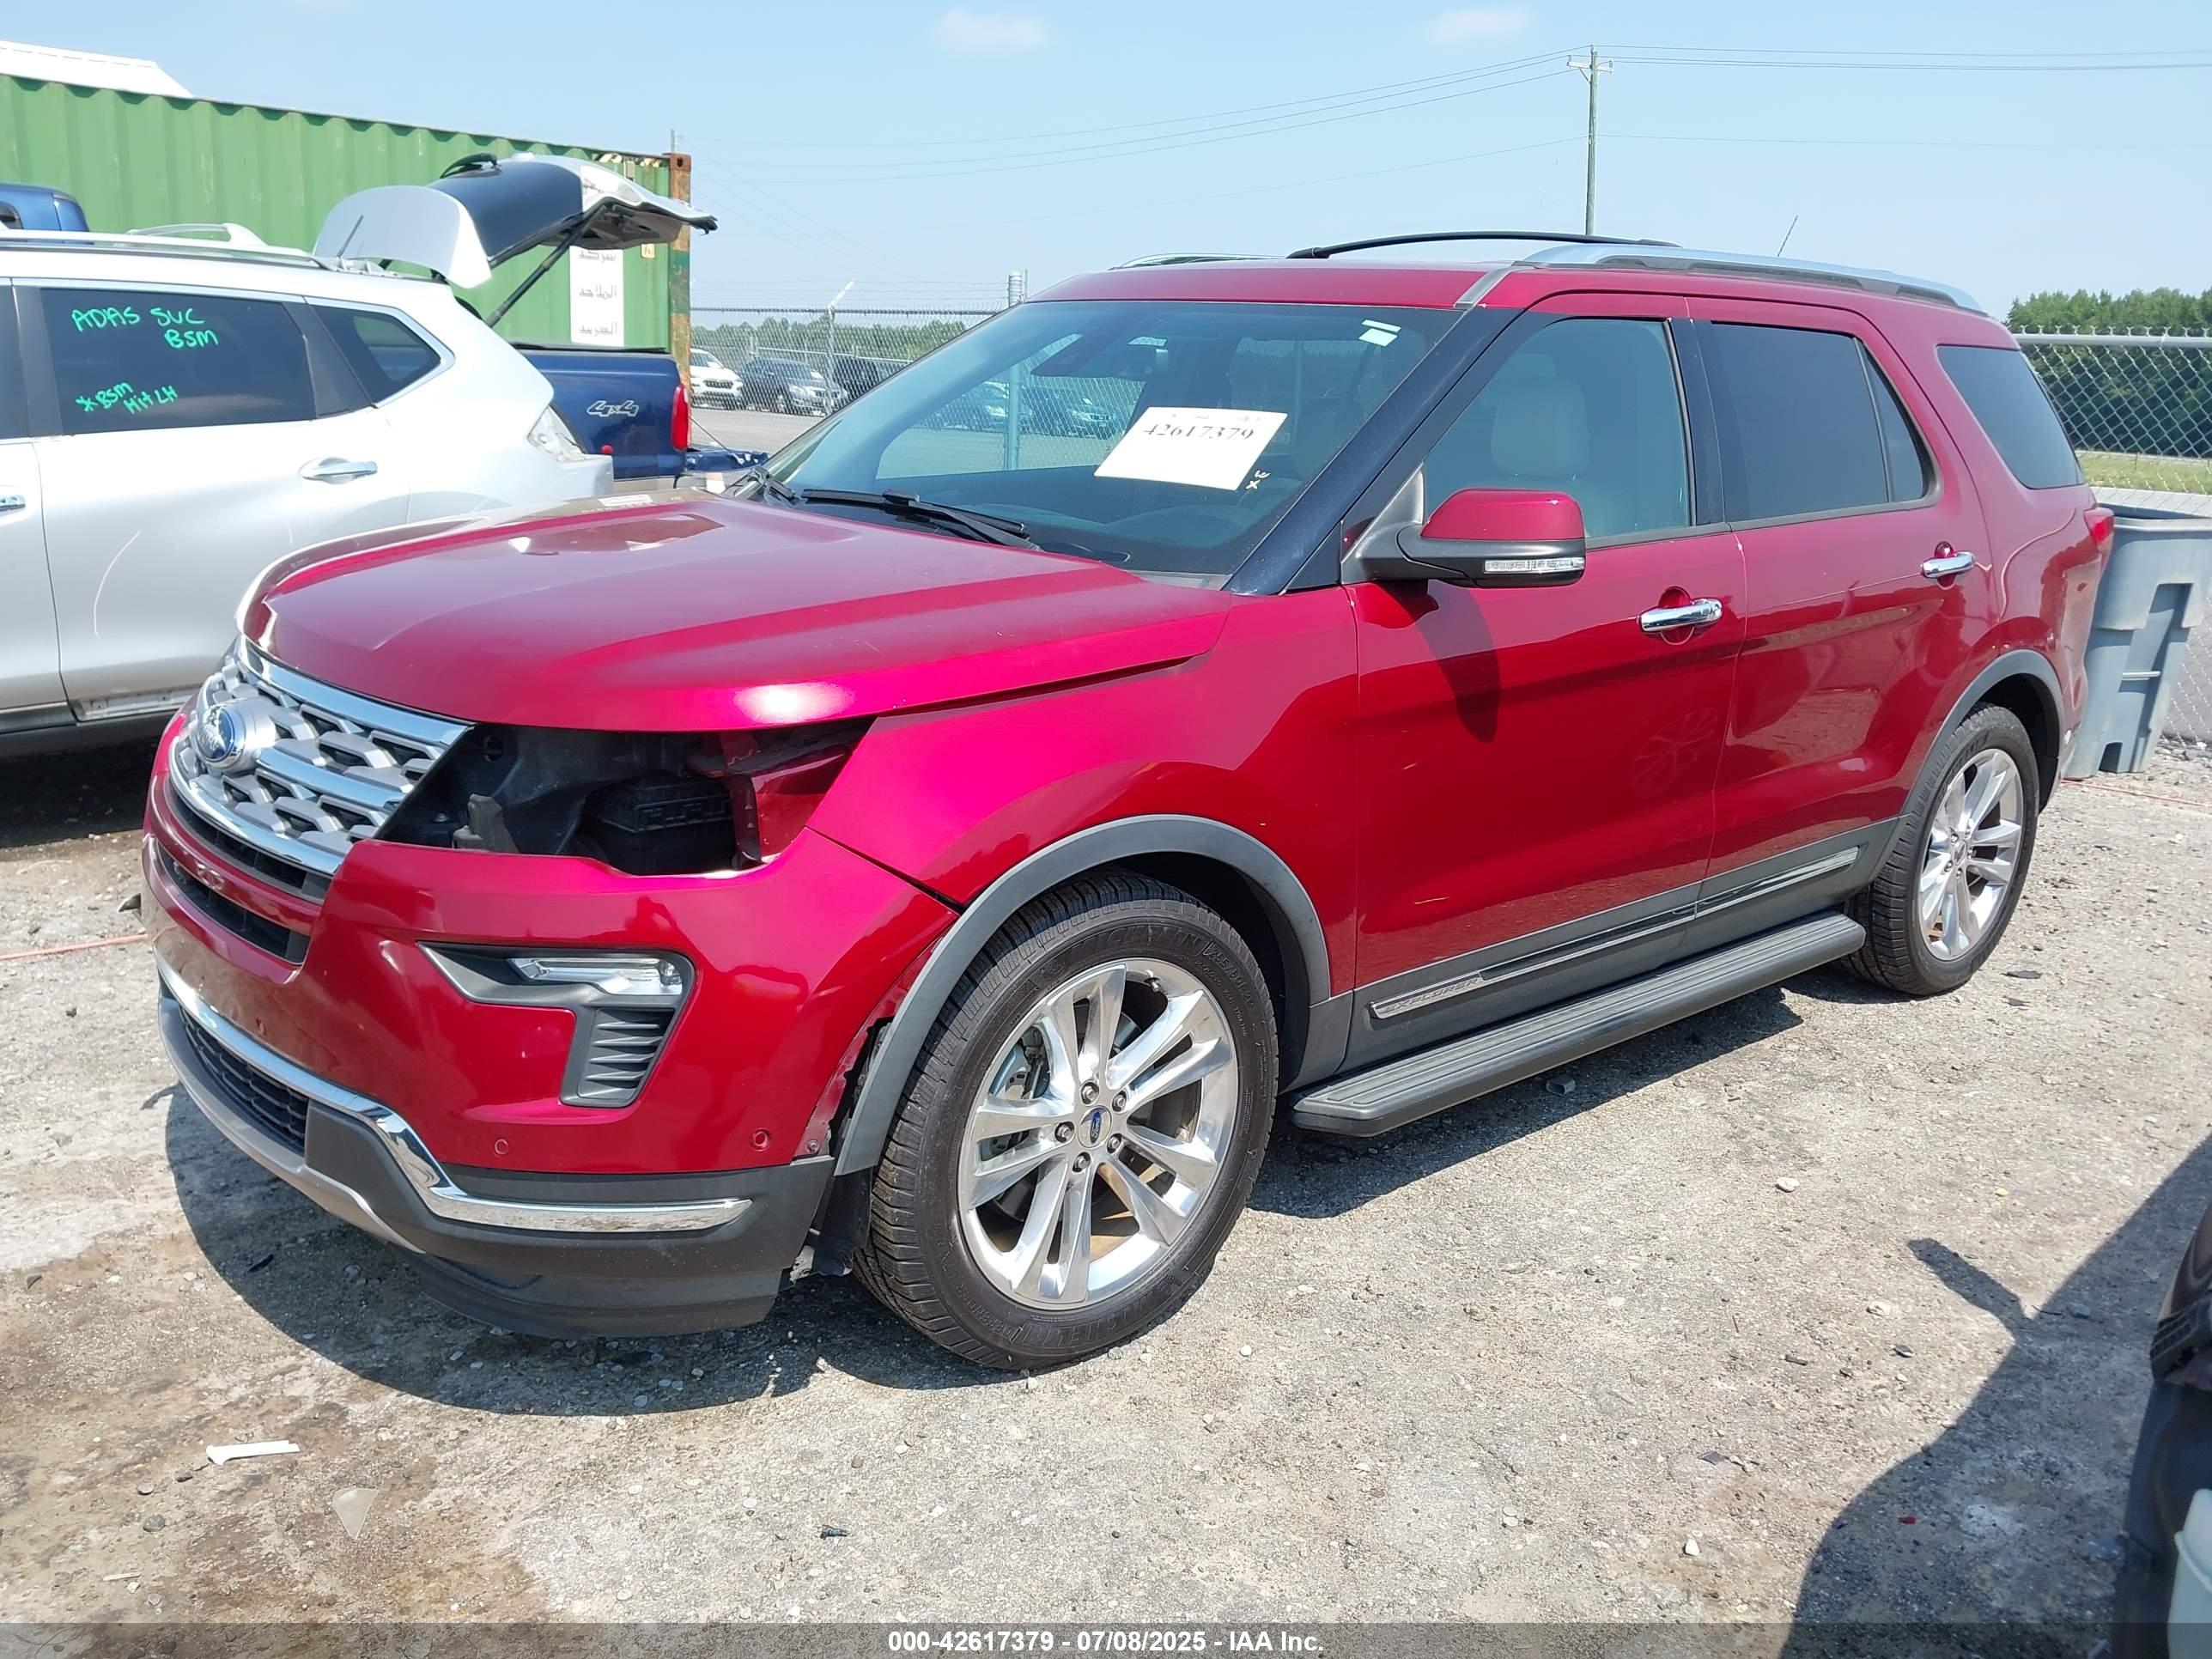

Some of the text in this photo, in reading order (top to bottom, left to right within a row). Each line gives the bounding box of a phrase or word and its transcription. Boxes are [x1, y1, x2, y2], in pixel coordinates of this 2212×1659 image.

[71, 306, 141, 332] ADAS
[586, 399, 639, 417] 4x4
[1143, 423, 1255, 440] 42617379
[1382, 976, 1479, 1013] EXPLORER
